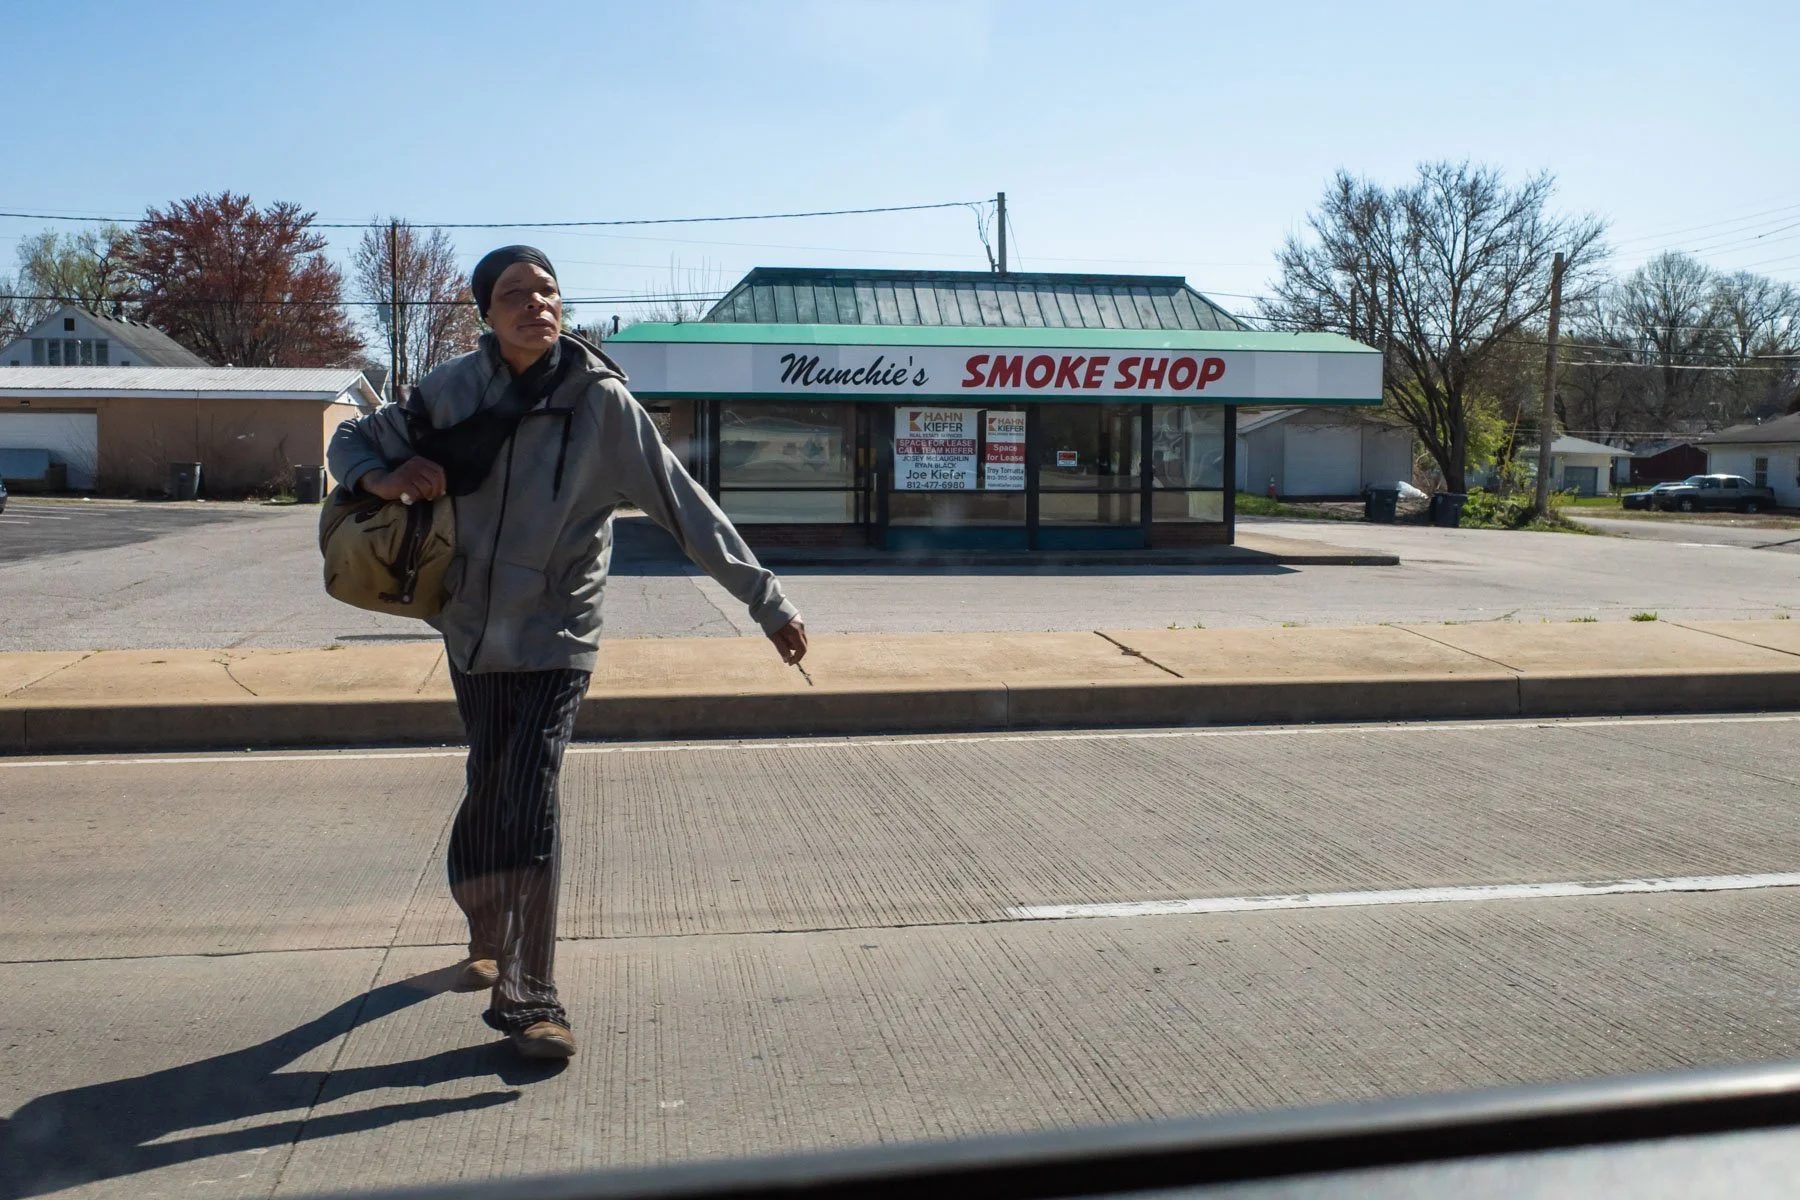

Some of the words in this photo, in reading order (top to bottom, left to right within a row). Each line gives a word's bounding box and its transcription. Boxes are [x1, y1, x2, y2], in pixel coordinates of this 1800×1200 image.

[780, 353, 929, 386] Munchie's
[962, 355, 1110, 389] SMOKE
[1114, 357, 1226, 391] SHOP
[924, 412, 963, 421] HAHN
[924, 422, 963, 432] KIEFER
[994, 444, 1017, 452] Space
[906, 470, 927, 479] Joe
[931, 470, 966, 479] Kiefer
